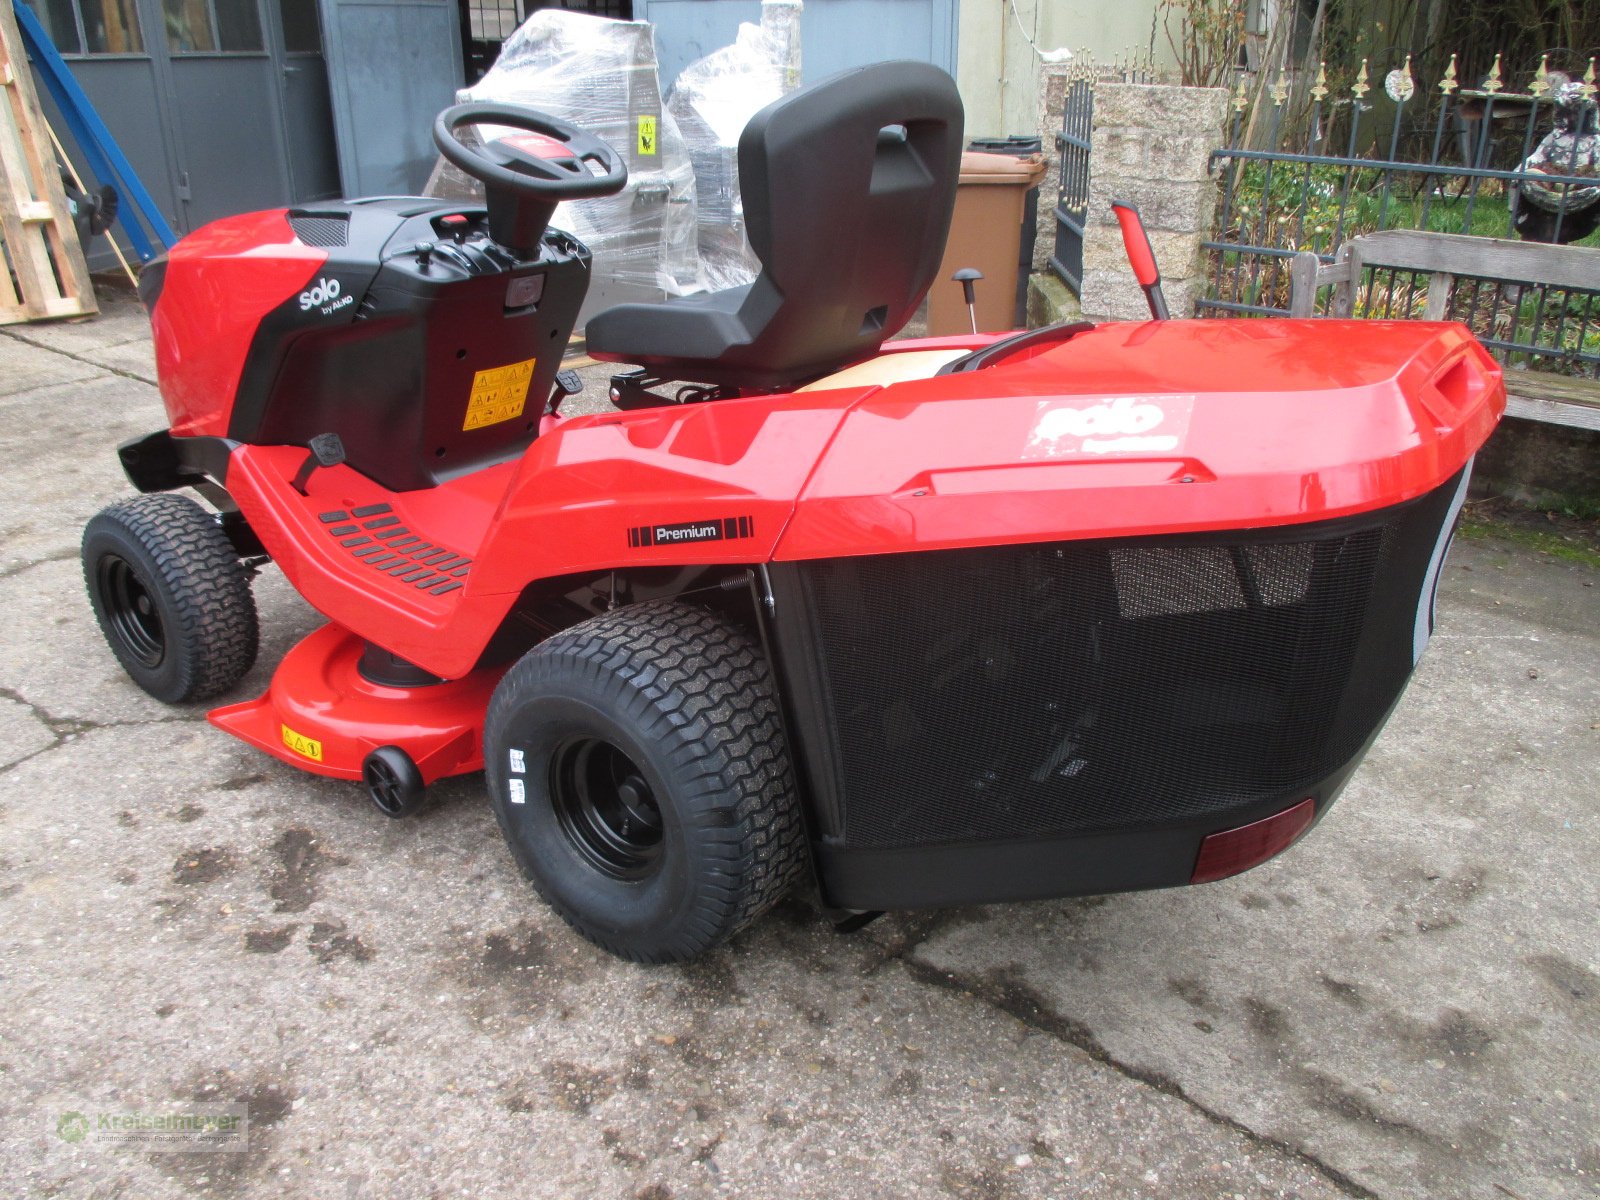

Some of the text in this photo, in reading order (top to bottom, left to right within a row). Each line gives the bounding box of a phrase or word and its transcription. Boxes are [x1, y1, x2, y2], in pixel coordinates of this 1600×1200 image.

[299, 278, 341, 311] solo
[321, 306, 333, 315] by
[656, 525, 717, 541] Premium
